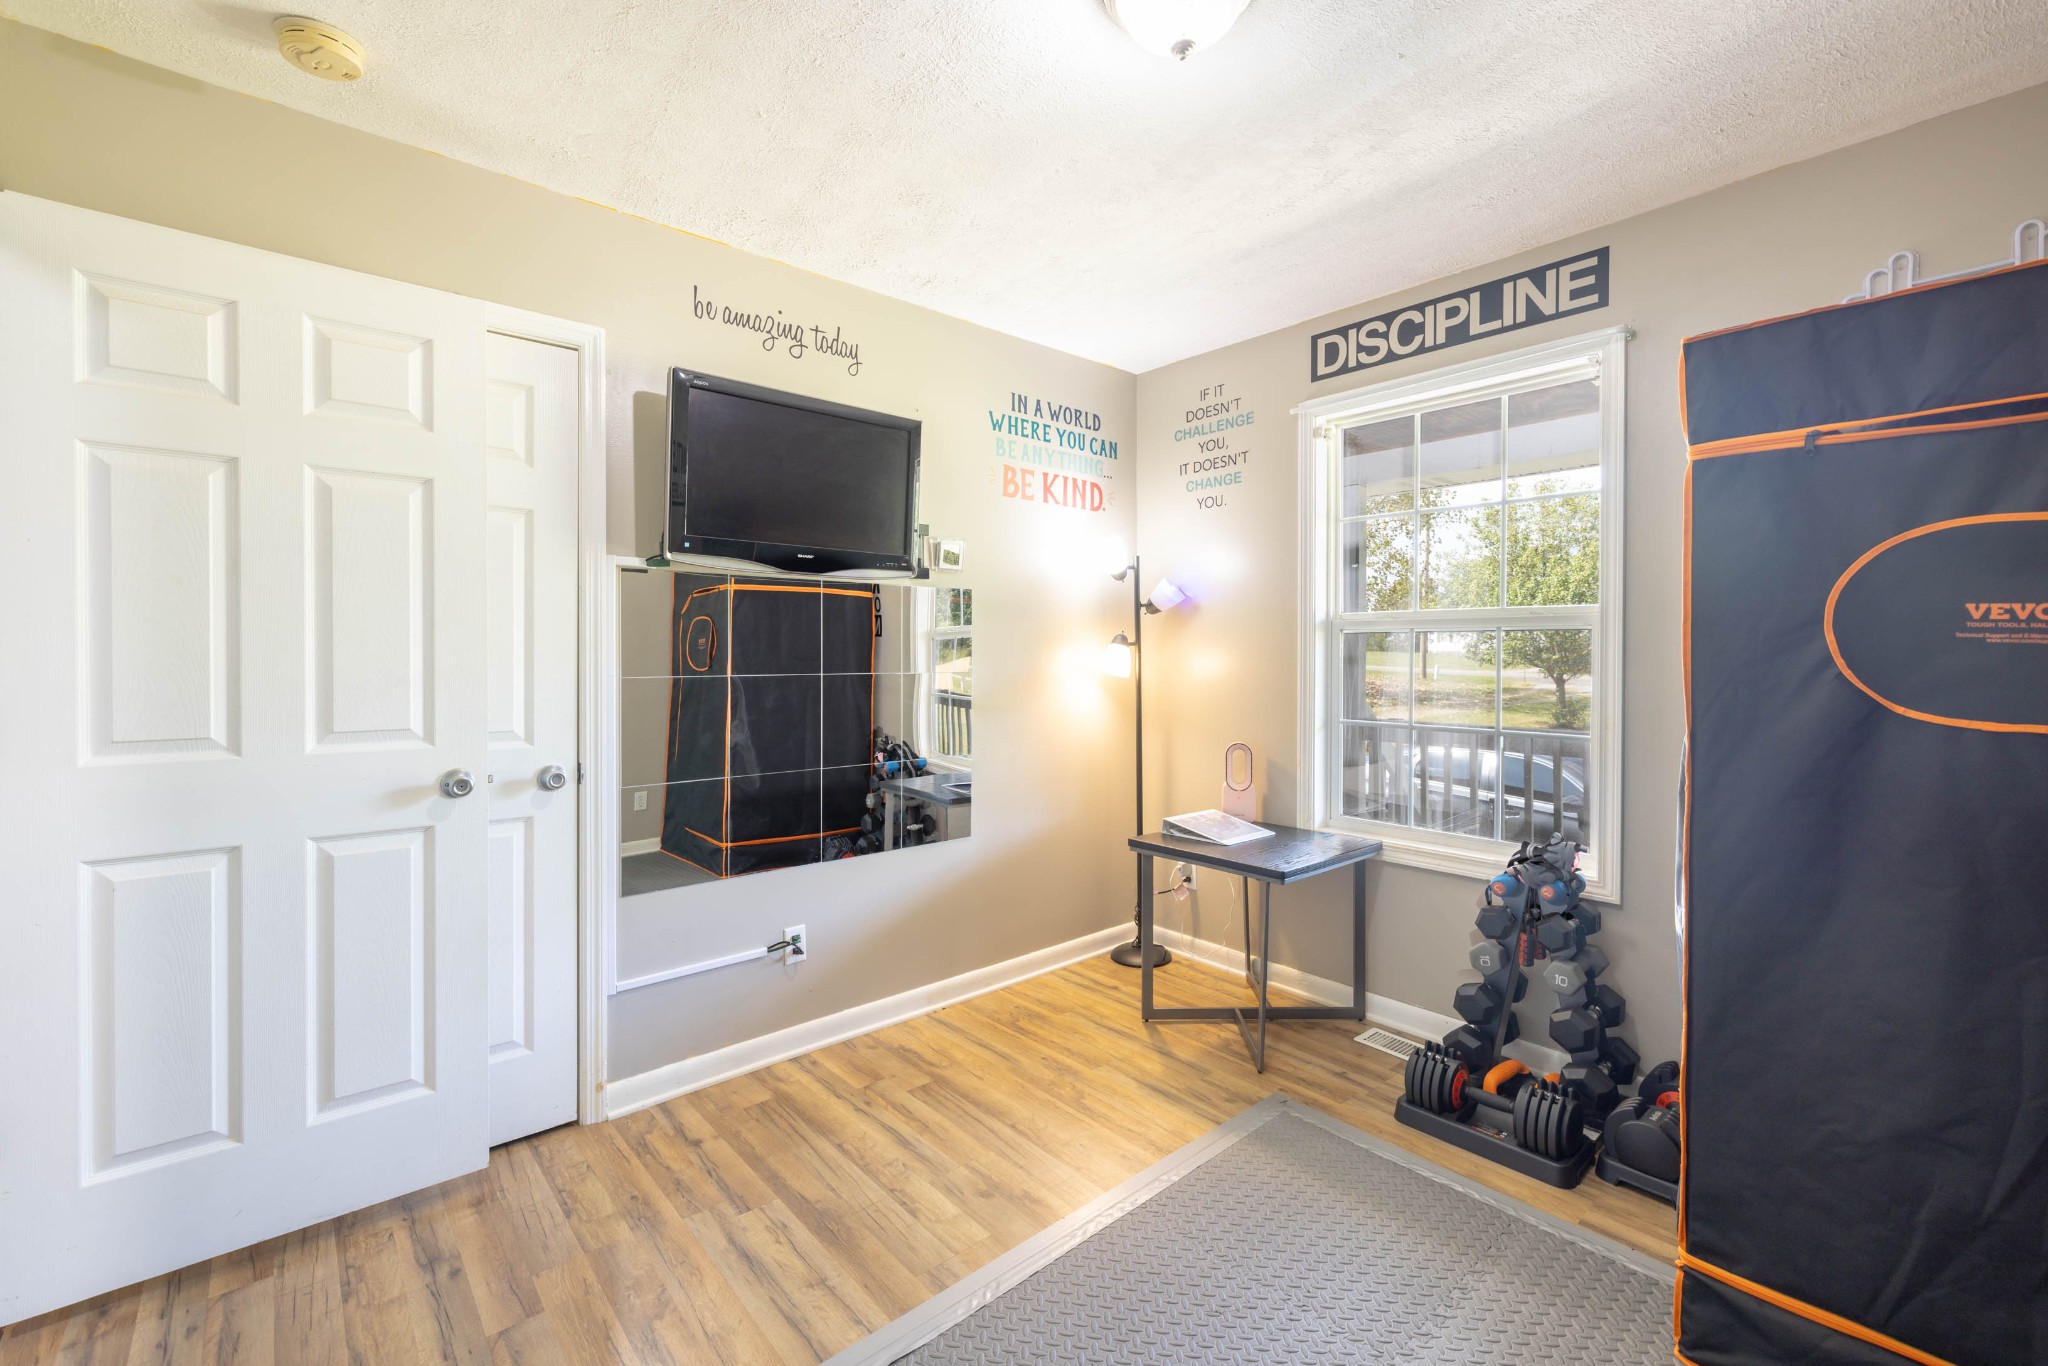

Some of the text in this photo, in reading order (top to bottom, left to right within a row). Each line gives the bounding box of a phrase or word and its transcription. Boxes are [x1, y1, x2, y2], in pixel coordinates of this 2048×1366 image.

[1317, 255, 1599, 376] DISCIPLINE
[693, 285, 862, 376] be amazing today
[1199, 383, 1225, 401] IF IT
[1011, 392, 1101, 432] IN A WORLD
[1186, 397, 1241, 423] DOESN'T
[989, 410, 1118, 460] WHERE YOU CAN
[1174, 411, 1255, 442] CHALLENGE
[995, 436, 1017, 460] BE
[1198, 436, 1229, 453] YOU,
[1179, 450, 1249, 476] IT DOESN'T
[1002, 464, 1106, 512] BE KIND.
[1186, 471, 1242, 493] CHANGE
[1196, 494, 1227, 510] YOU.
[1479, 955, 1491, 966] 10
[1554, 974, 1568, 987] 10
